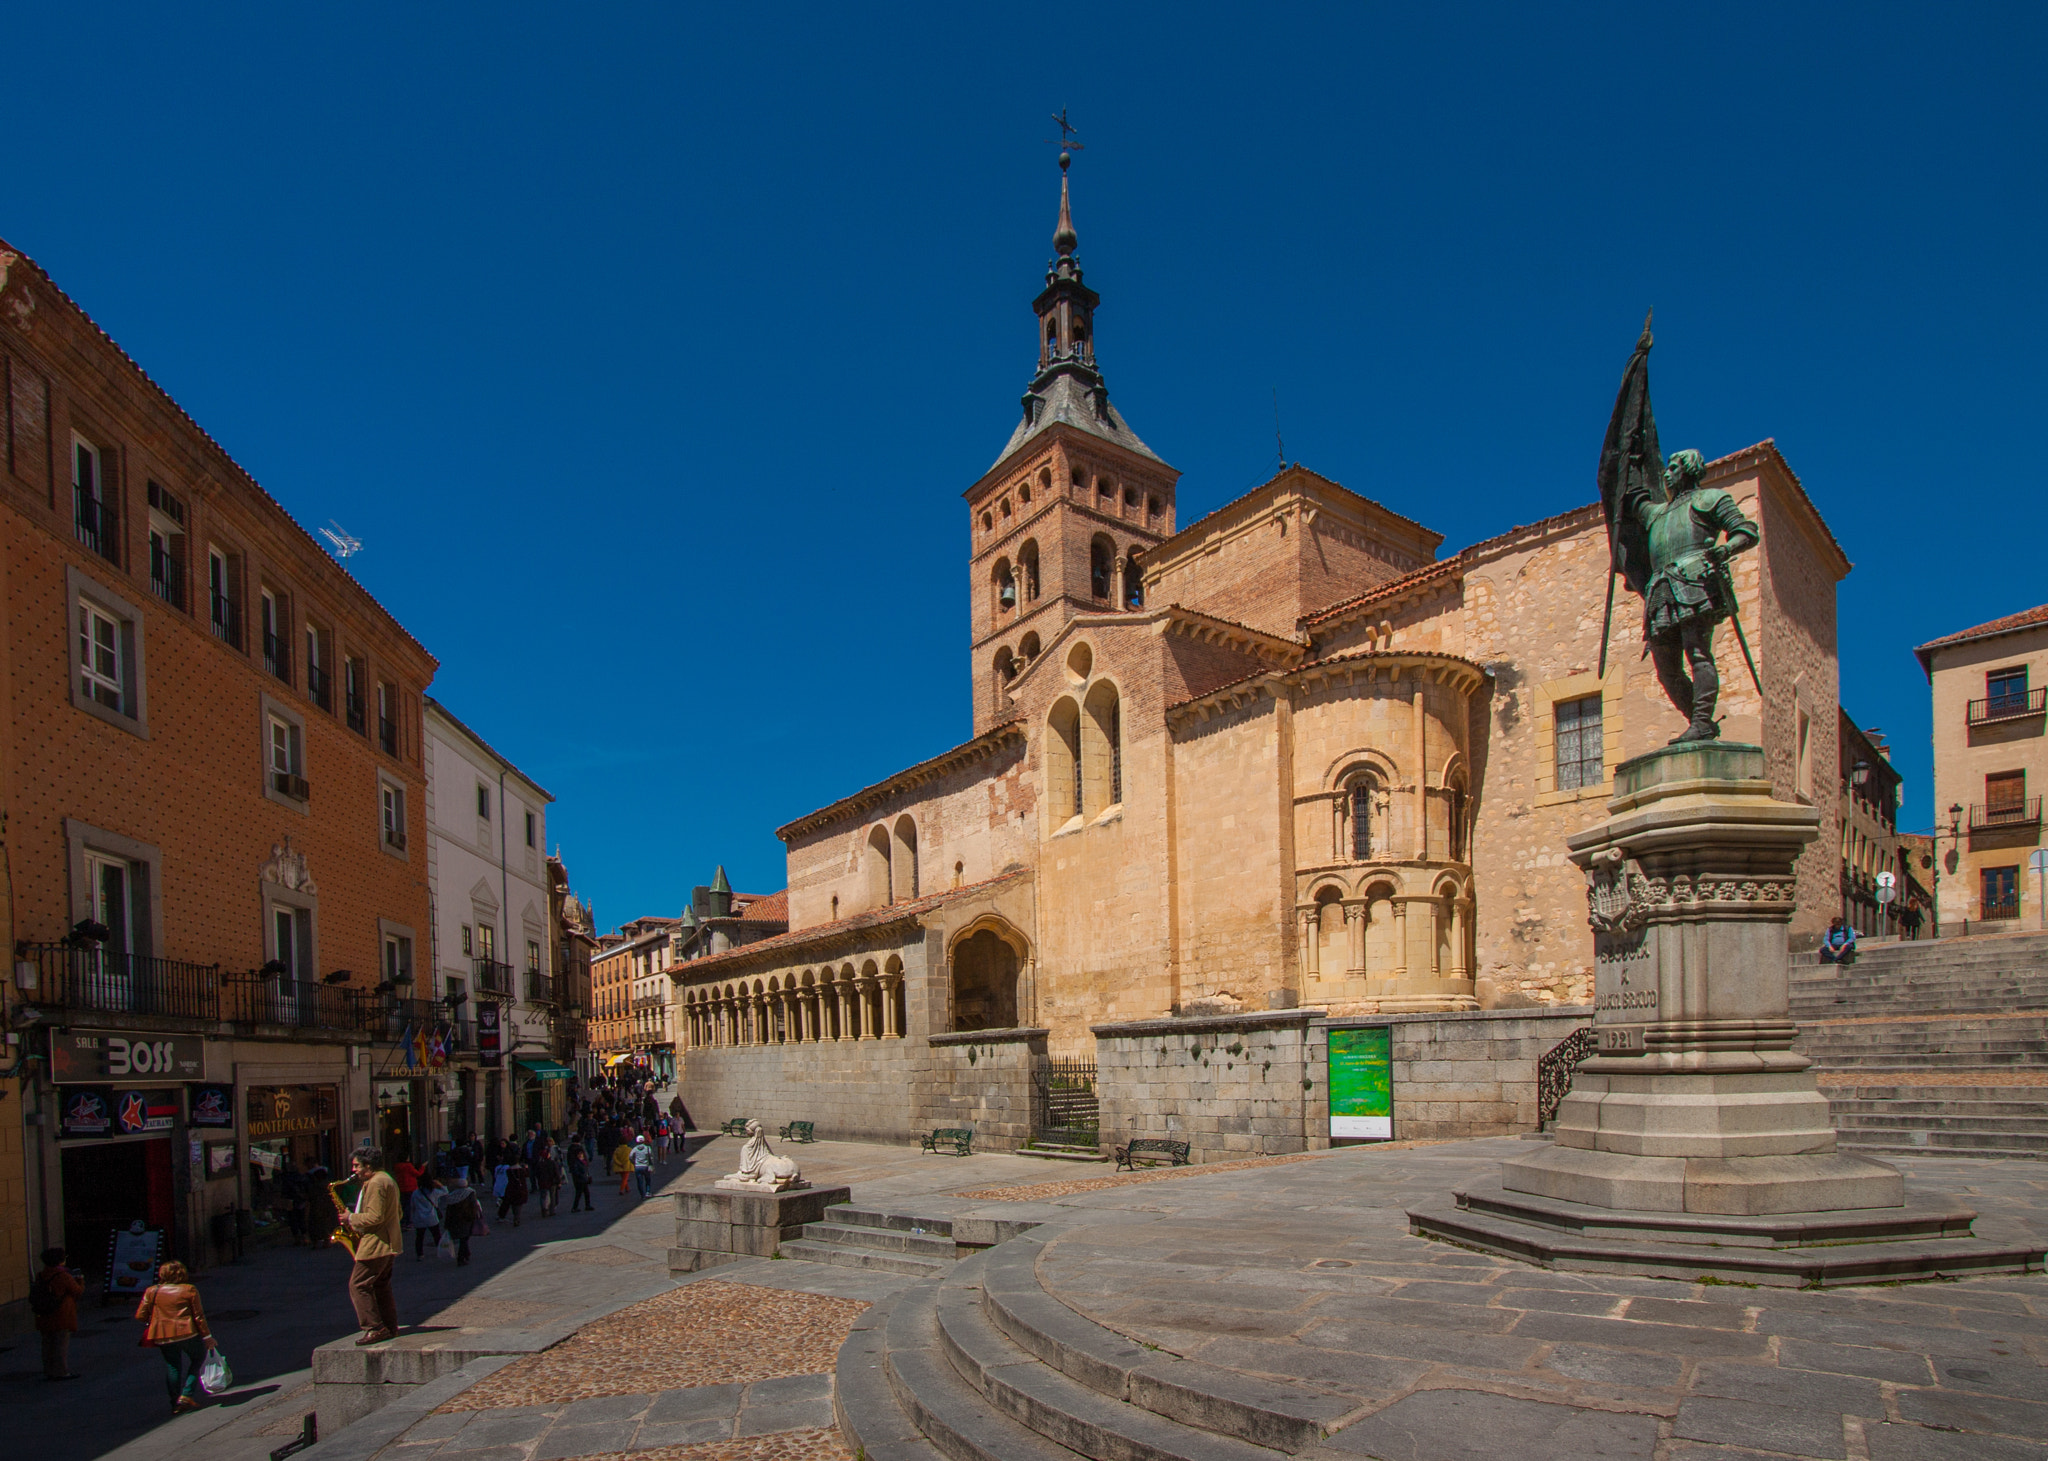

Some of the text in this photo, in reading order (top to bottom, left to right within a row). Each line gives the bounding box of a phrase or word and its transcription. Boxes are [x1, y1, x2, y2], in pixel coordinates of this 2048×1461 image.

[1620, 967, 1630, 986] A
[75, 1036, 99, 1049] SALA
[1605, 1029, 1633, 1049] 1921
[107, 1037, 174, 1075] BOSS
[247, 1116, 317, 1136] MONTEPICAZA
